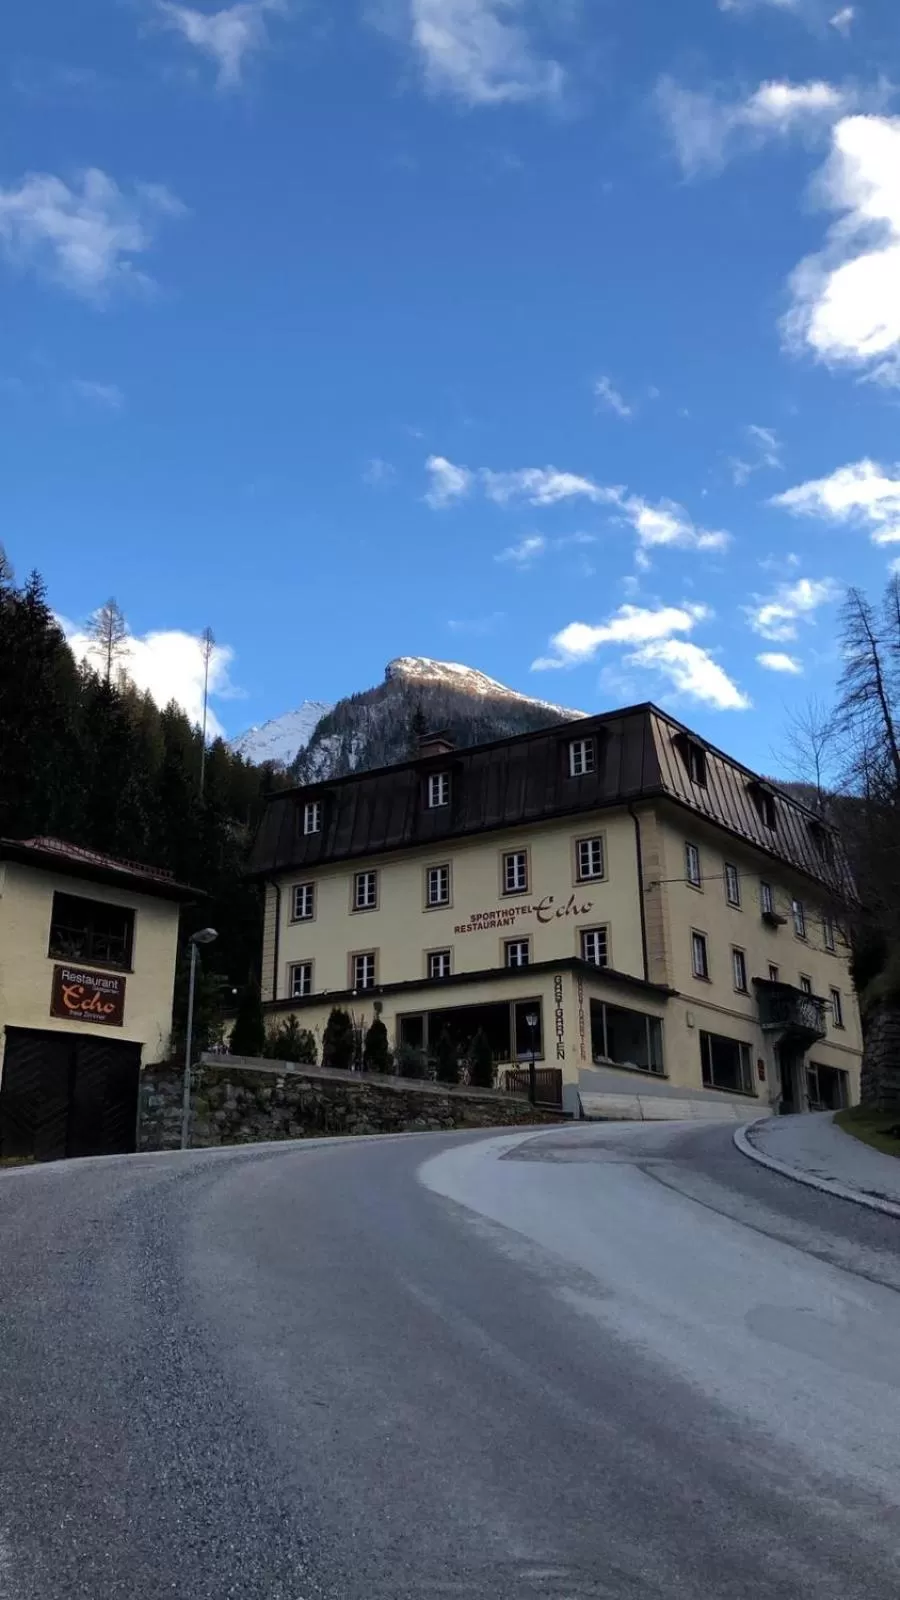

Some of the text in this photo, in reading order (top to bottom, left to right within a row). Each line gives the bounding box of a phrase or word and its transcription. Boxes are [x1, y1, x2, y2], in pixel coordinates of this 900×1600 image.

[470, 894, 594, 924] SPORTHOTEL Echo
[454, 916, 516, 934] RESTAURANT
[62, 969, 118, 989] Restaurant
[61, 984, 116, 1013] Echo
[554, 975, 565, 1060] GASTGARTEN
